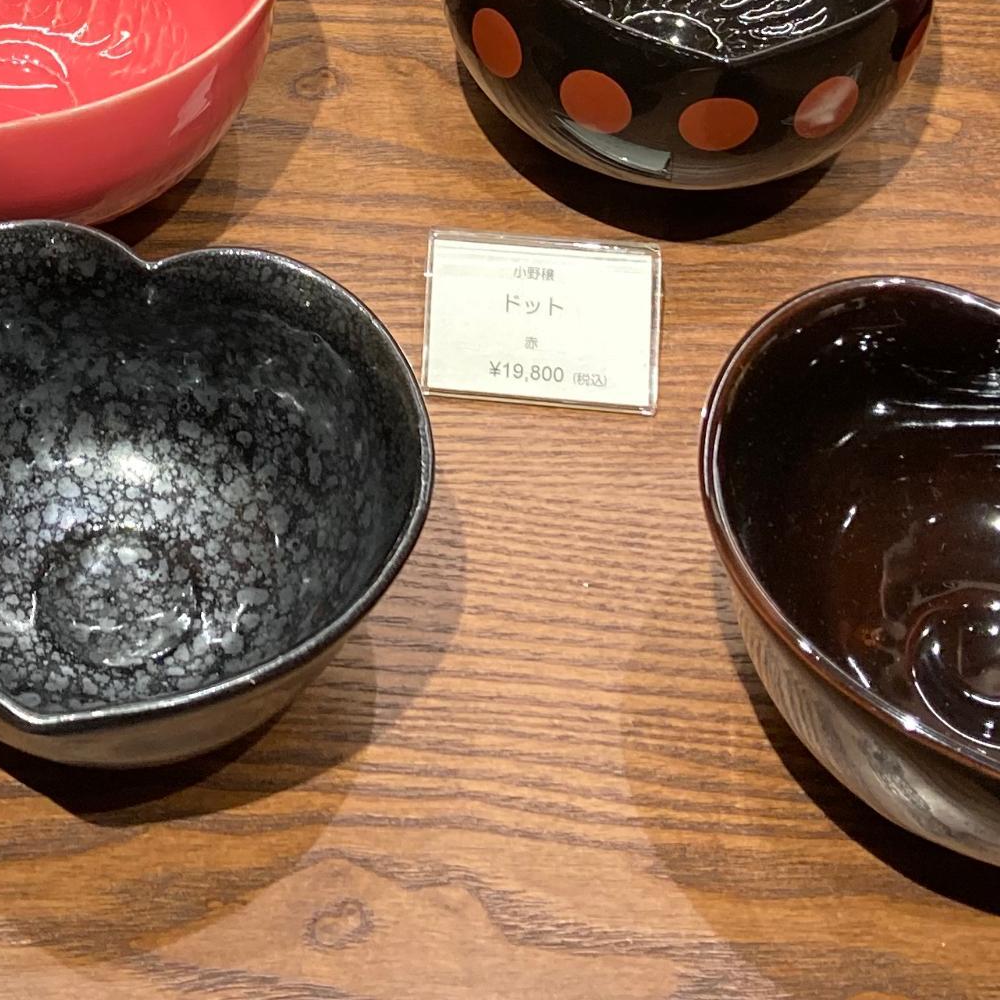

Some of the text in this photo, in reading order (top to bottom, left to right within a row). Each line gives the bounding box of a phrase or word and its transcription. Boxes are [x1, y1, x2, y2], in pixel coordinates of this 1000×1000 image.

[505, 293, 564, 317] ドット
[489, 360, 565, 383] ¥19,800
